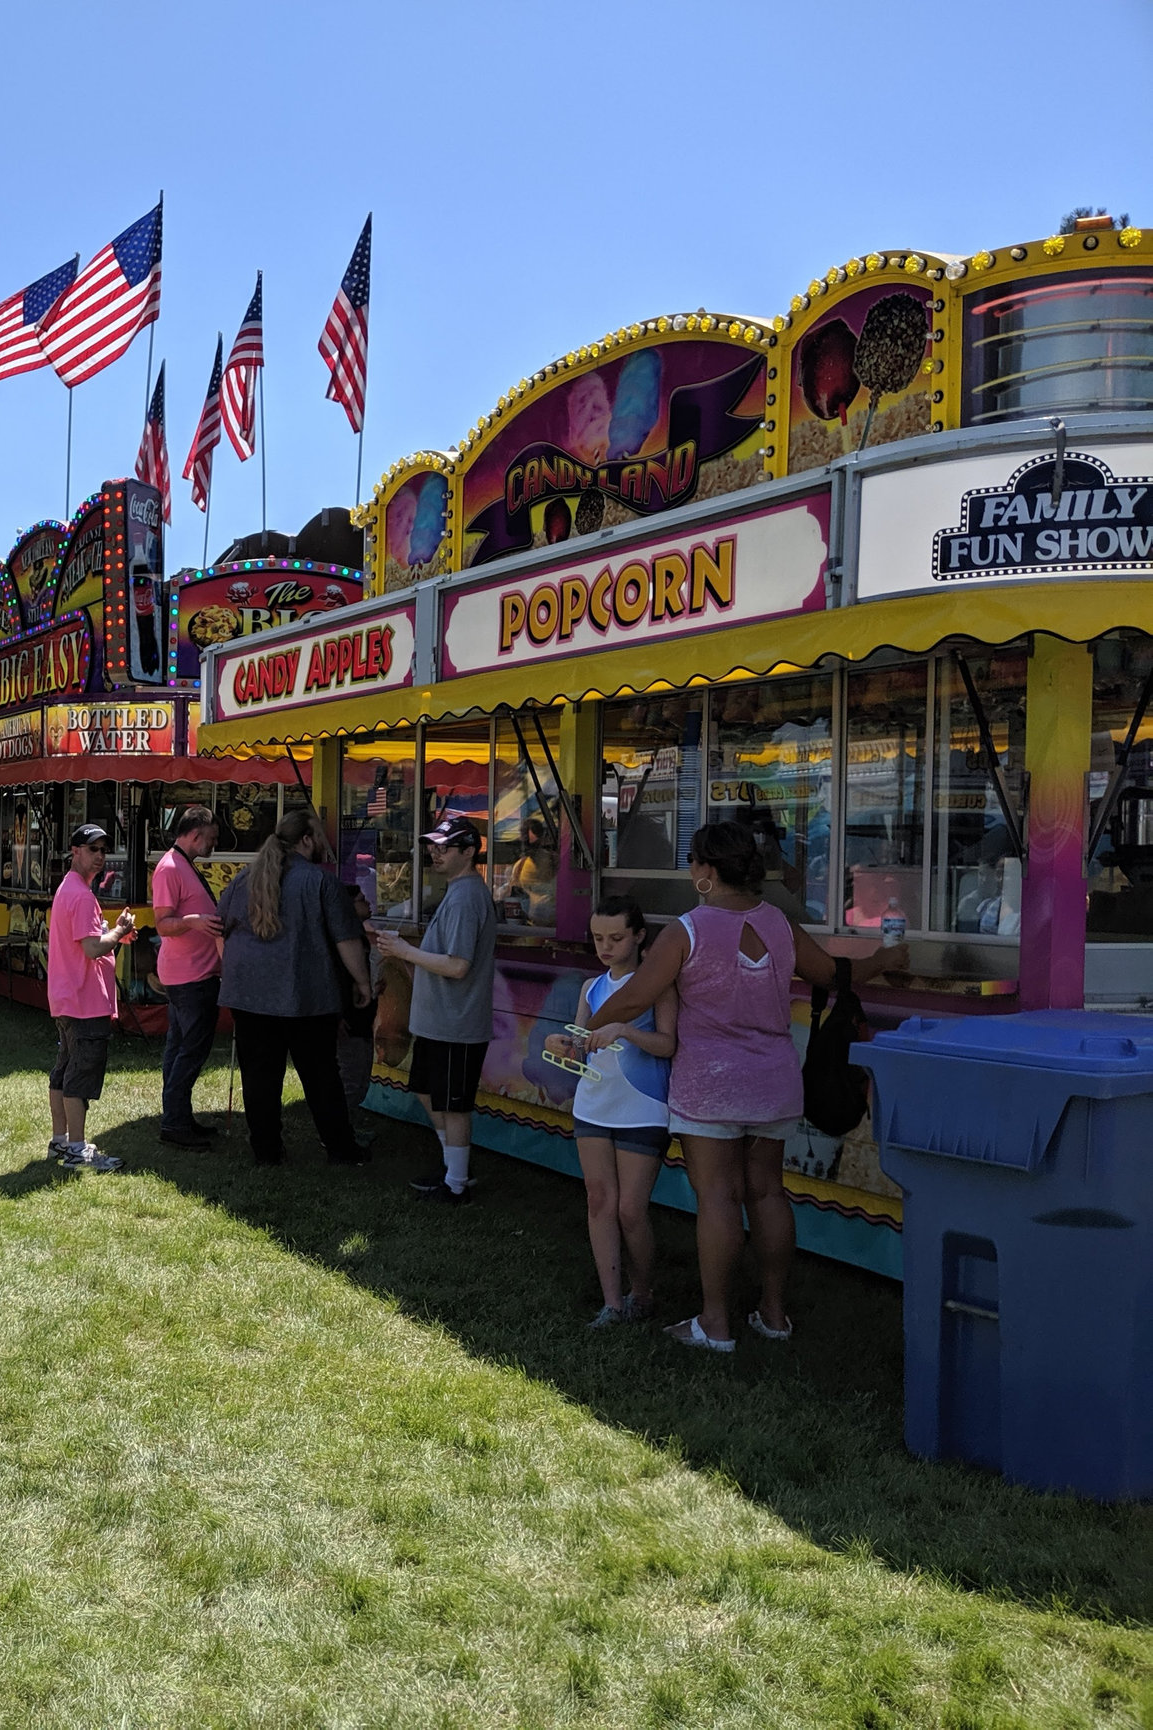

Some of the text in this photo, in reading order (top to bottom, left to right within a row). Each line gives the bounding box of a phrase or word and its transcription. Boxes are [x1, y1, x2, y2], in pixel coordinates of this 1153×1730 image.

[506, 440, 696, 515] CANDY LAND
[979, 487, 1148, 528] FAMILY
[949, 532, 1024, 568] FUN
[264, 580, 311, 604] The
[500, 538, 734, 653] POPCORN
[237, 607, 328, 637] BI
[0, 650, 30, 706] BIG
[32, 628, 86, 697] EASY
[233, 625, 395, 706] CANDY APPLES
[67, 708, 167, 730] BOTTLED
[8, 735, 34, 759] DOGS
[78, 730, 151, 751] WATER
